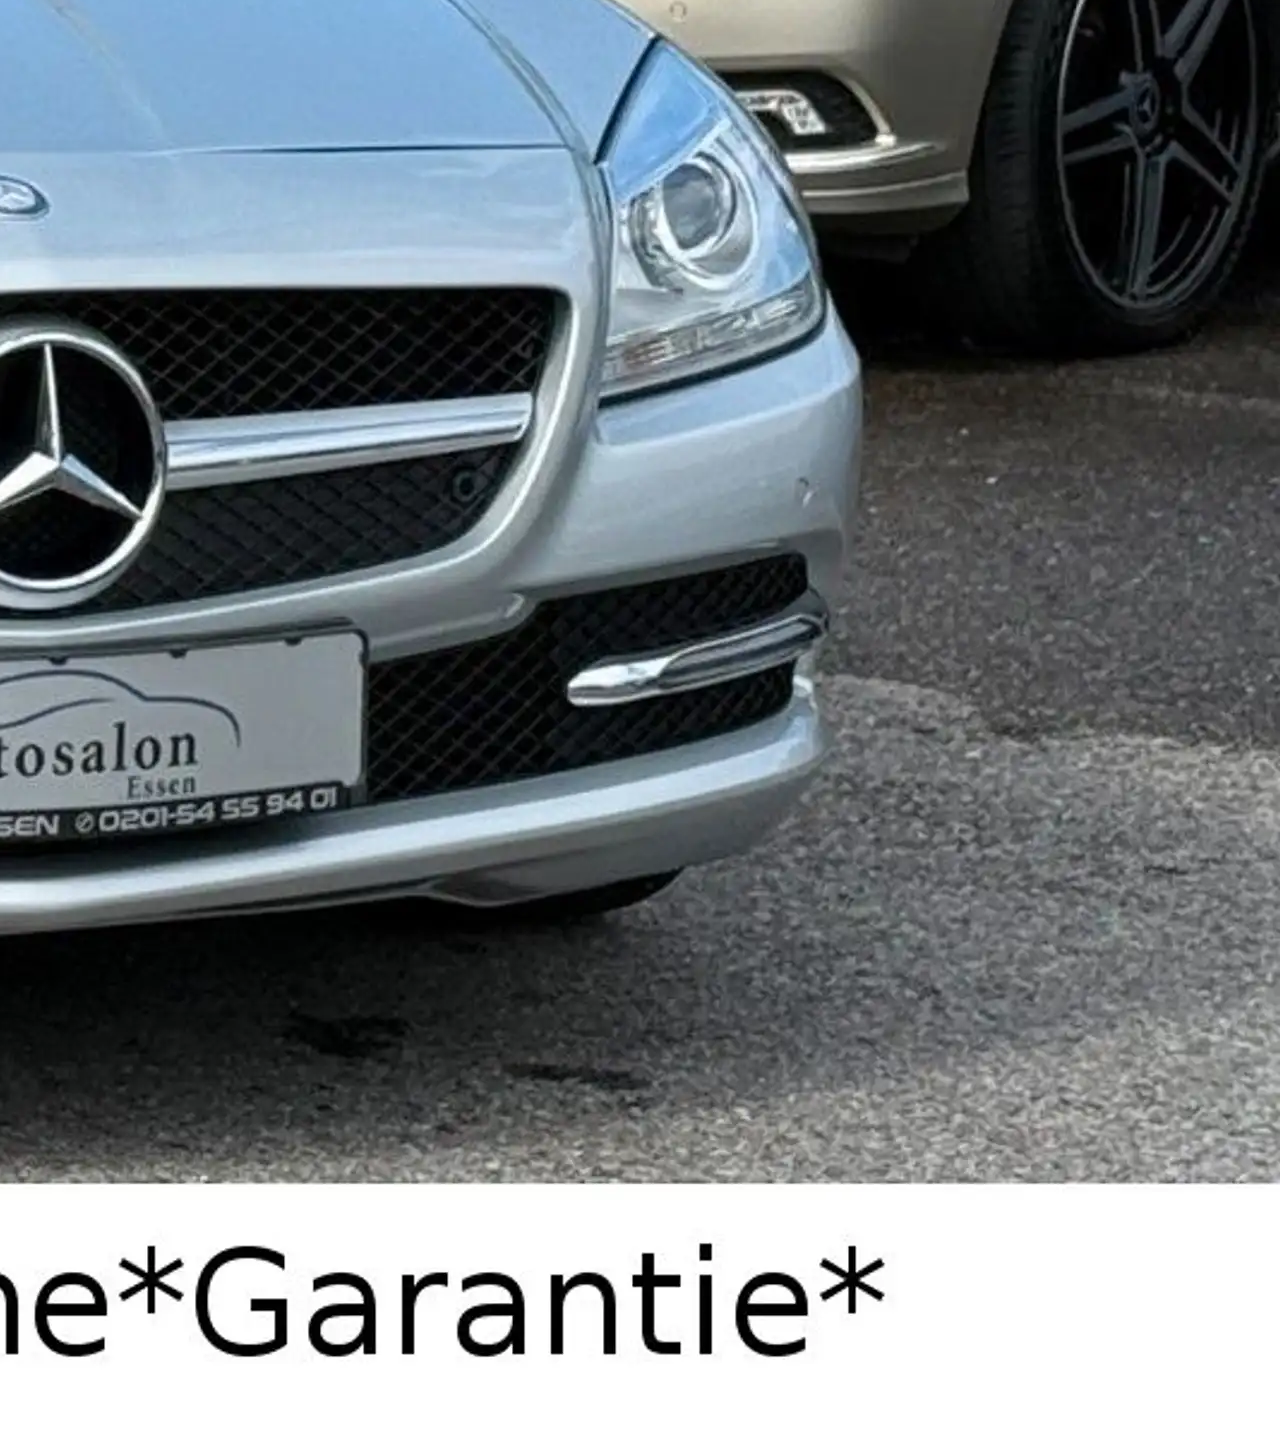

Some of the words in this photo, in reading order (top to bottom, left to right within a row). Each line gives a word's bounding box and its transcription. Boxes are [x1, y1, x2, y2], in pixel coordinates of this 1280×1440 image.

[126, 775, 197, 801] Essen
[98, 800, 215, 832] 0201-54
[220, 795, 260, 821] 55
[265, 790, 305, 816] 94
[309, 785, 339, 810] 01
